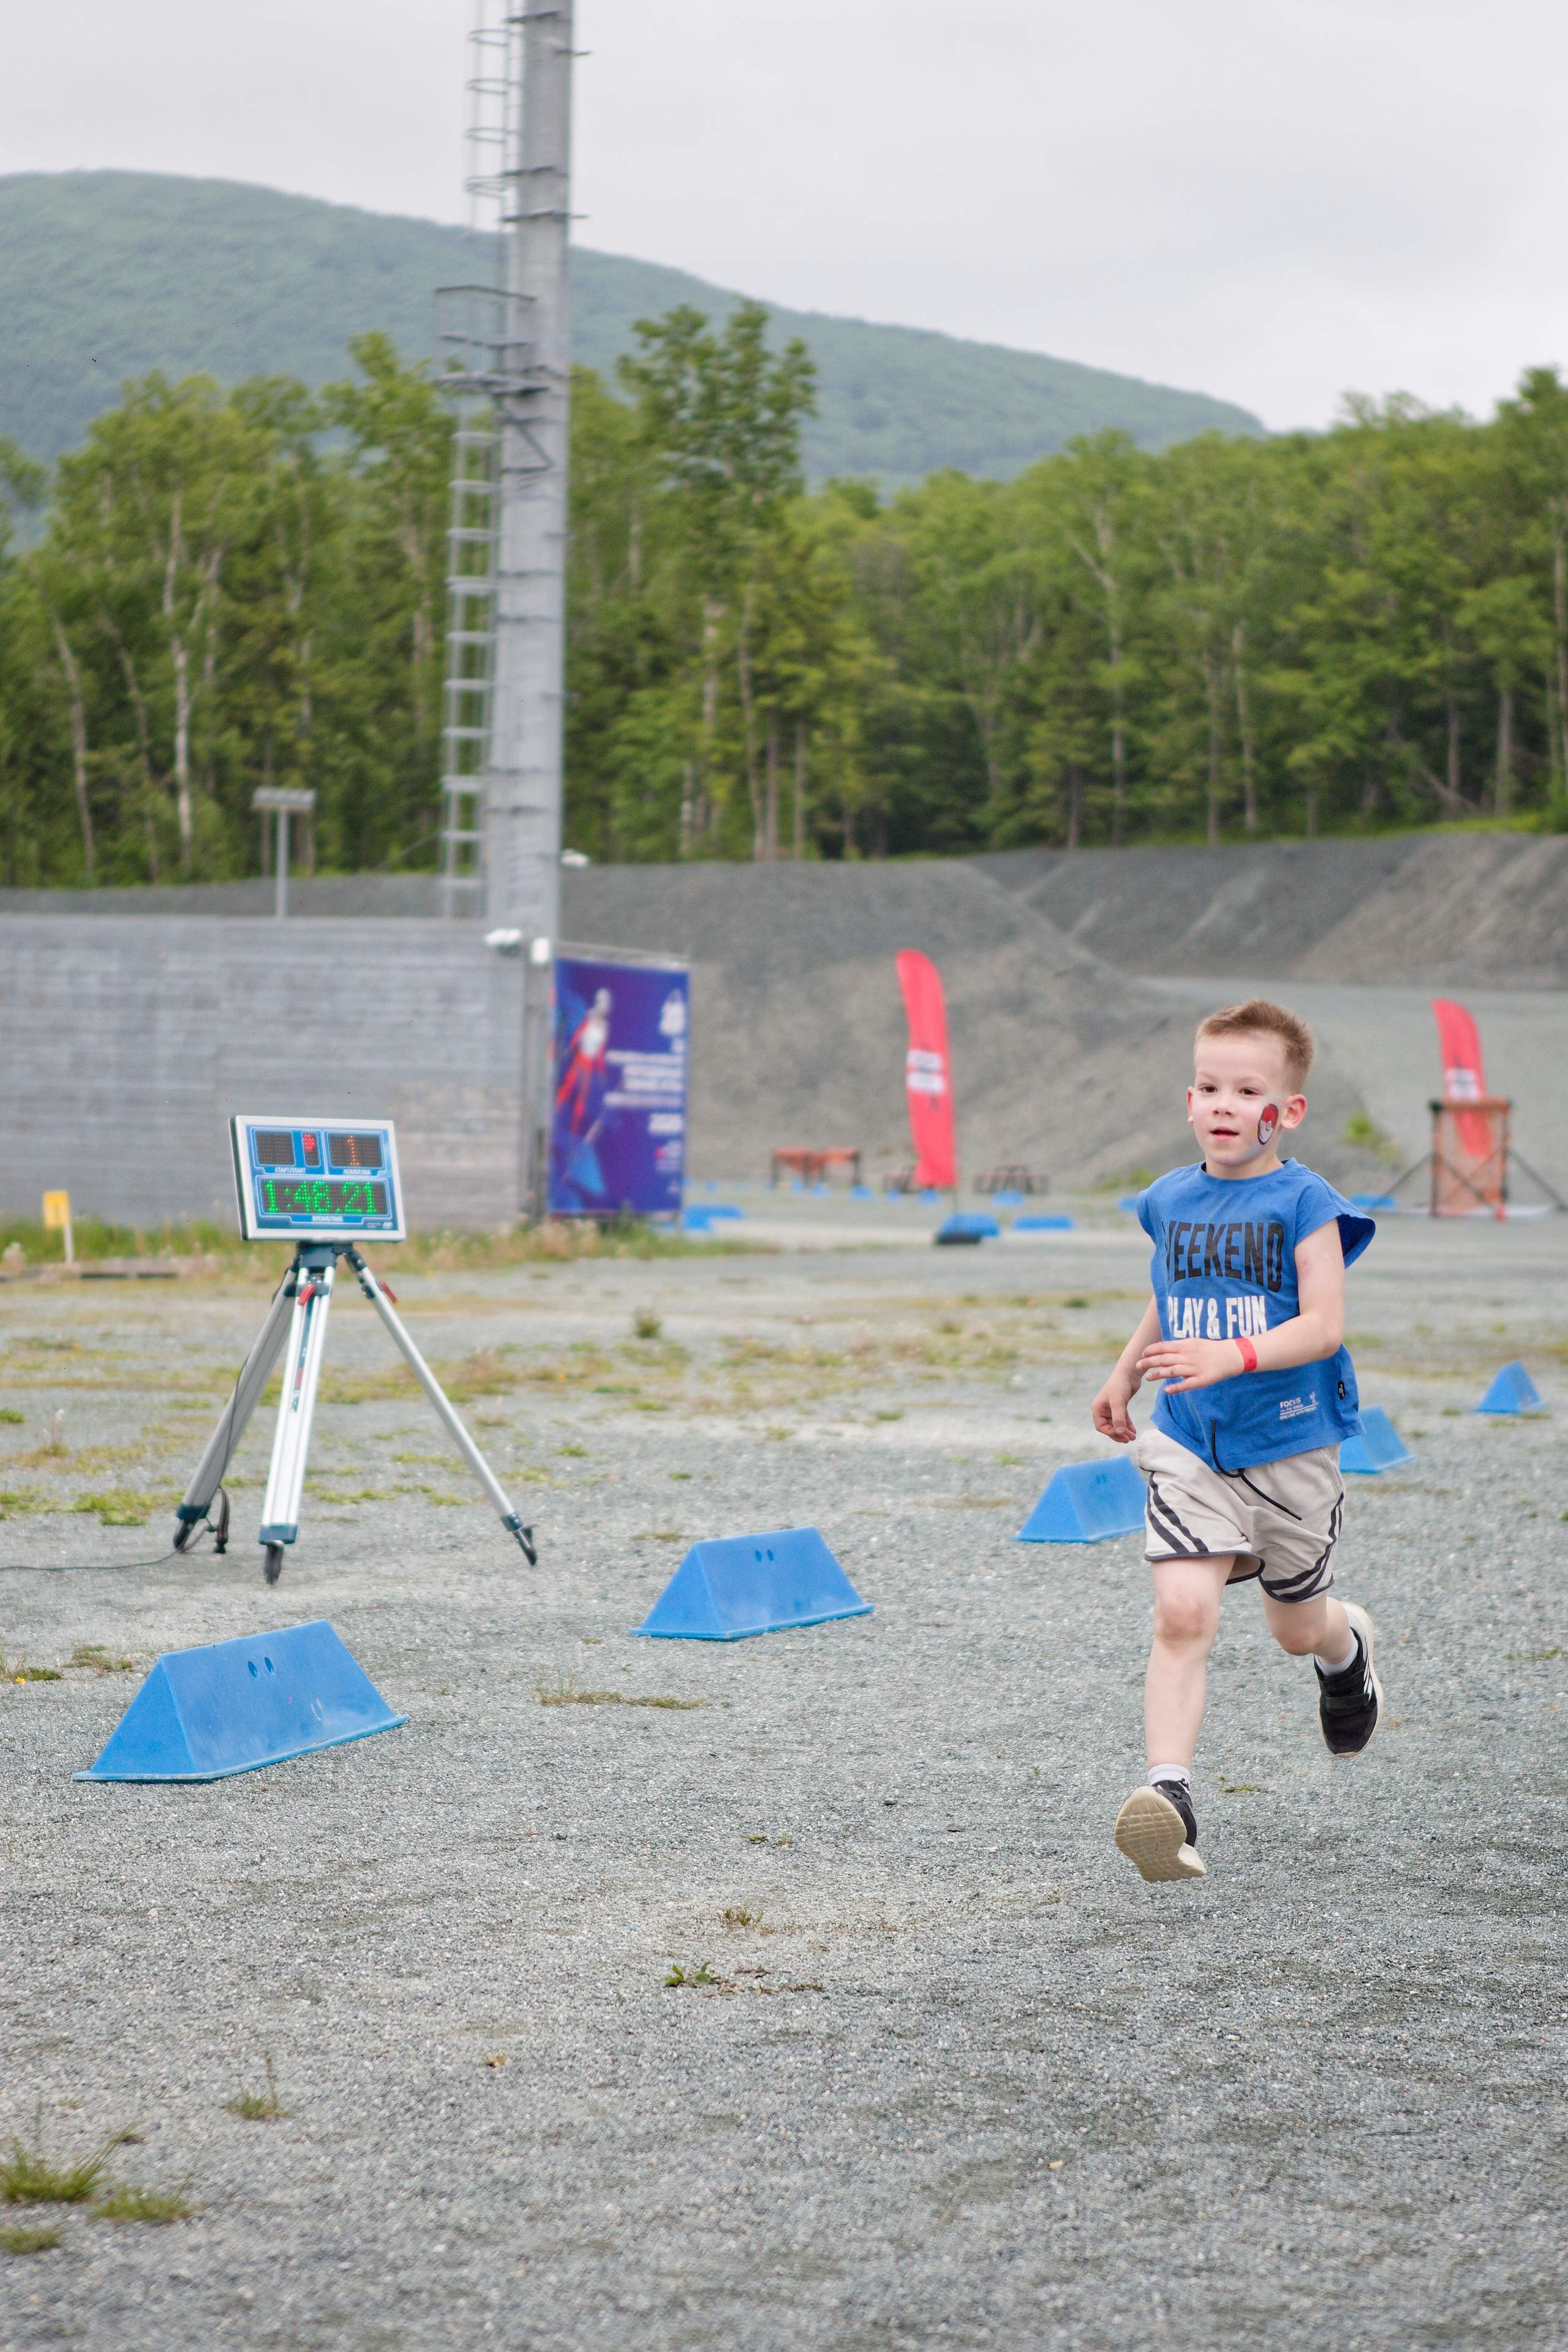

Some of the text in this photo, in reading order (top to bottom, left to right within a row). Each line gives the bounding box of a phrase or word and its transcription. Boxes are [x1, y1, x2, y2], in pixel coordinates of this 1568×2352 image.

[347, 1135, 360, 1166] 1
[265, 1179, 377, 1215] 1:48.21
[1207, 1298, 1221, 1340] &
[1226, 1295, 1267, 1339] FUN
[1280, 1397, 1301, 1408] FOCUS
